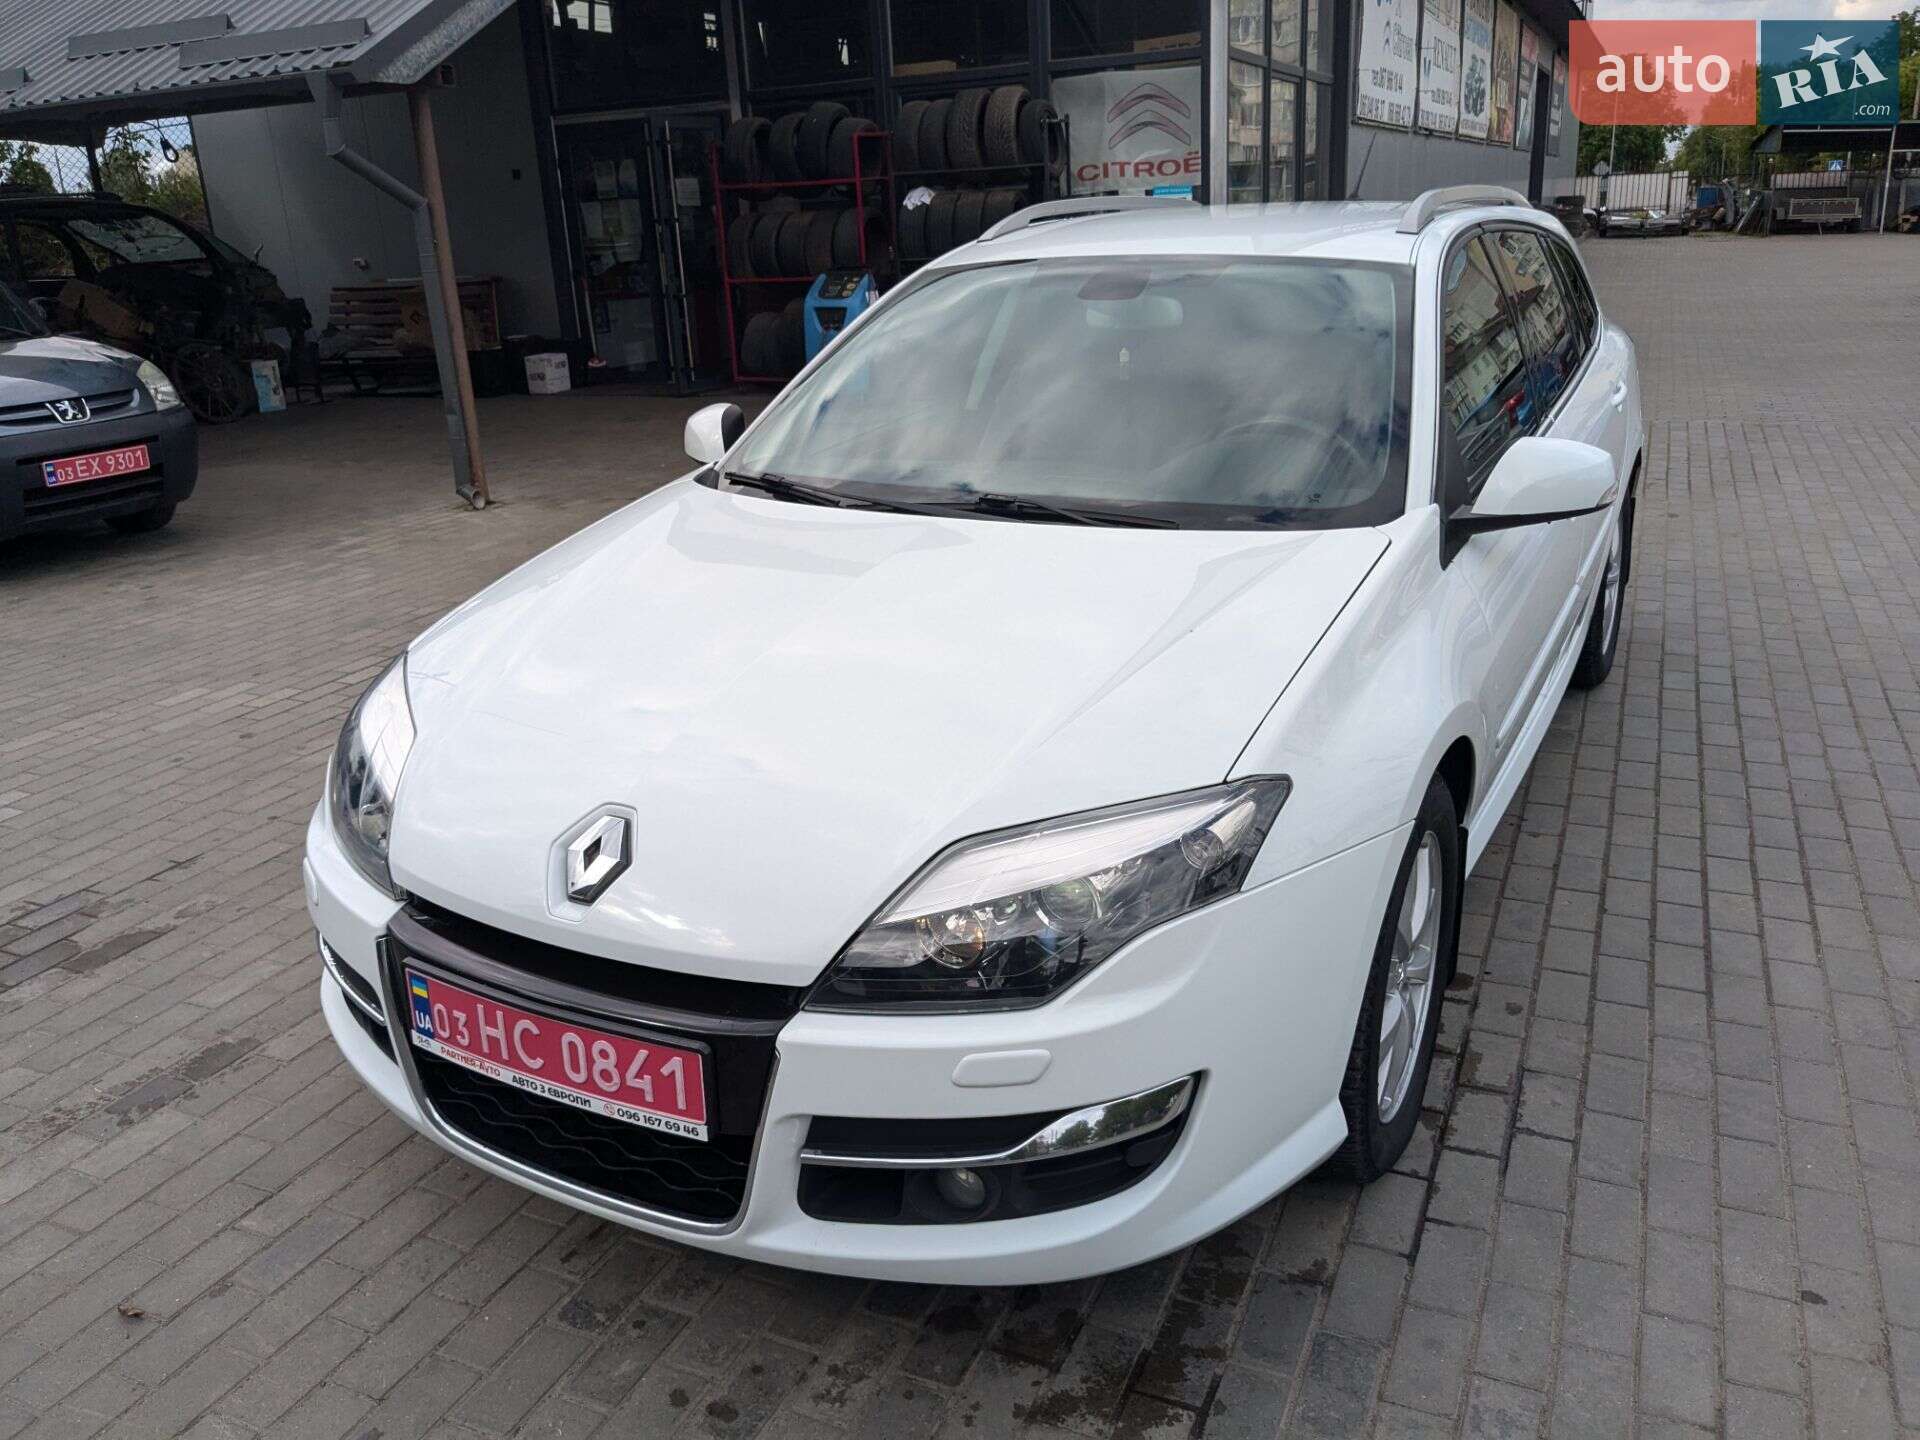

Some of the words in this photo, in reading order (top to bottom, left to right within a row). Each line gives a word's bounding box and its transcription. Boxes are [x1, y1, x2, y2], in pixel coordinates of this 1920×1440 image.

[56, 467, 74, 481] 03
[75, 458, 103, 477] EX
[105, 450, 145, 472] 9301
[415, 1010, 434, 1033] UA
[433, 1003, 470, 1047] 03
[476, 1003, 544, 1070] HC
[561, 1032, 687, 1111] 0841
[511, 1074, 538, 1092] АВТО
[547, 1087, 592, 1109] ЄВРОПИ
[617, 1107, 641, 1122] 096
[643, 1114, 662, 1128] 167
[664, 1121, 681, 1132] 69
[683, 1126, 700, 1137] 46
